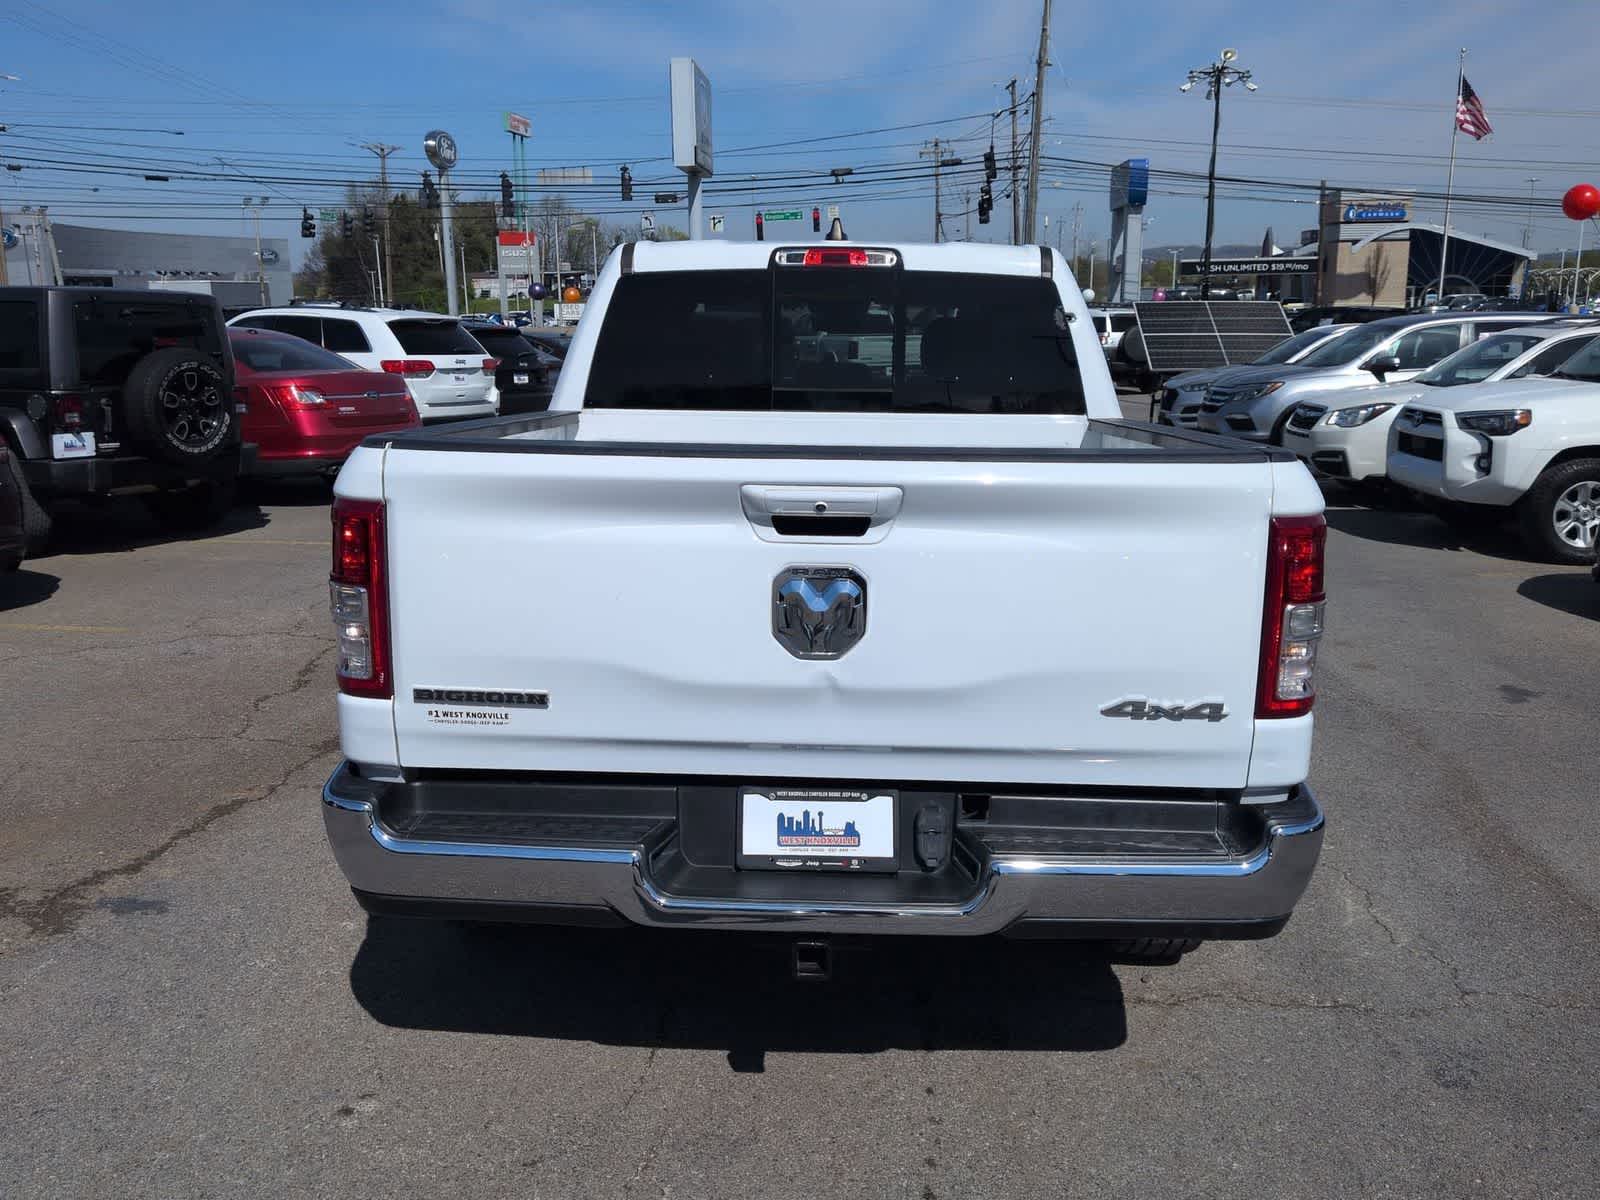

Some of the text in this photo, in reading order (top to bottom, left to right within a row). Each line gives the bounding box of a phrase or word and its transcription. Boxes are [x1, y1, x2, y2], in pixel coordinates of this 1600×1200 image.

[1223, 264, 1269, 272] UNLIMITED
[442, 710, 464, 718] WEST
[466, 711, 510, 720] KNOXVILLE
[1099, 700, 1230, 723] 4x4
[782, 836, 805, 844] WEST
